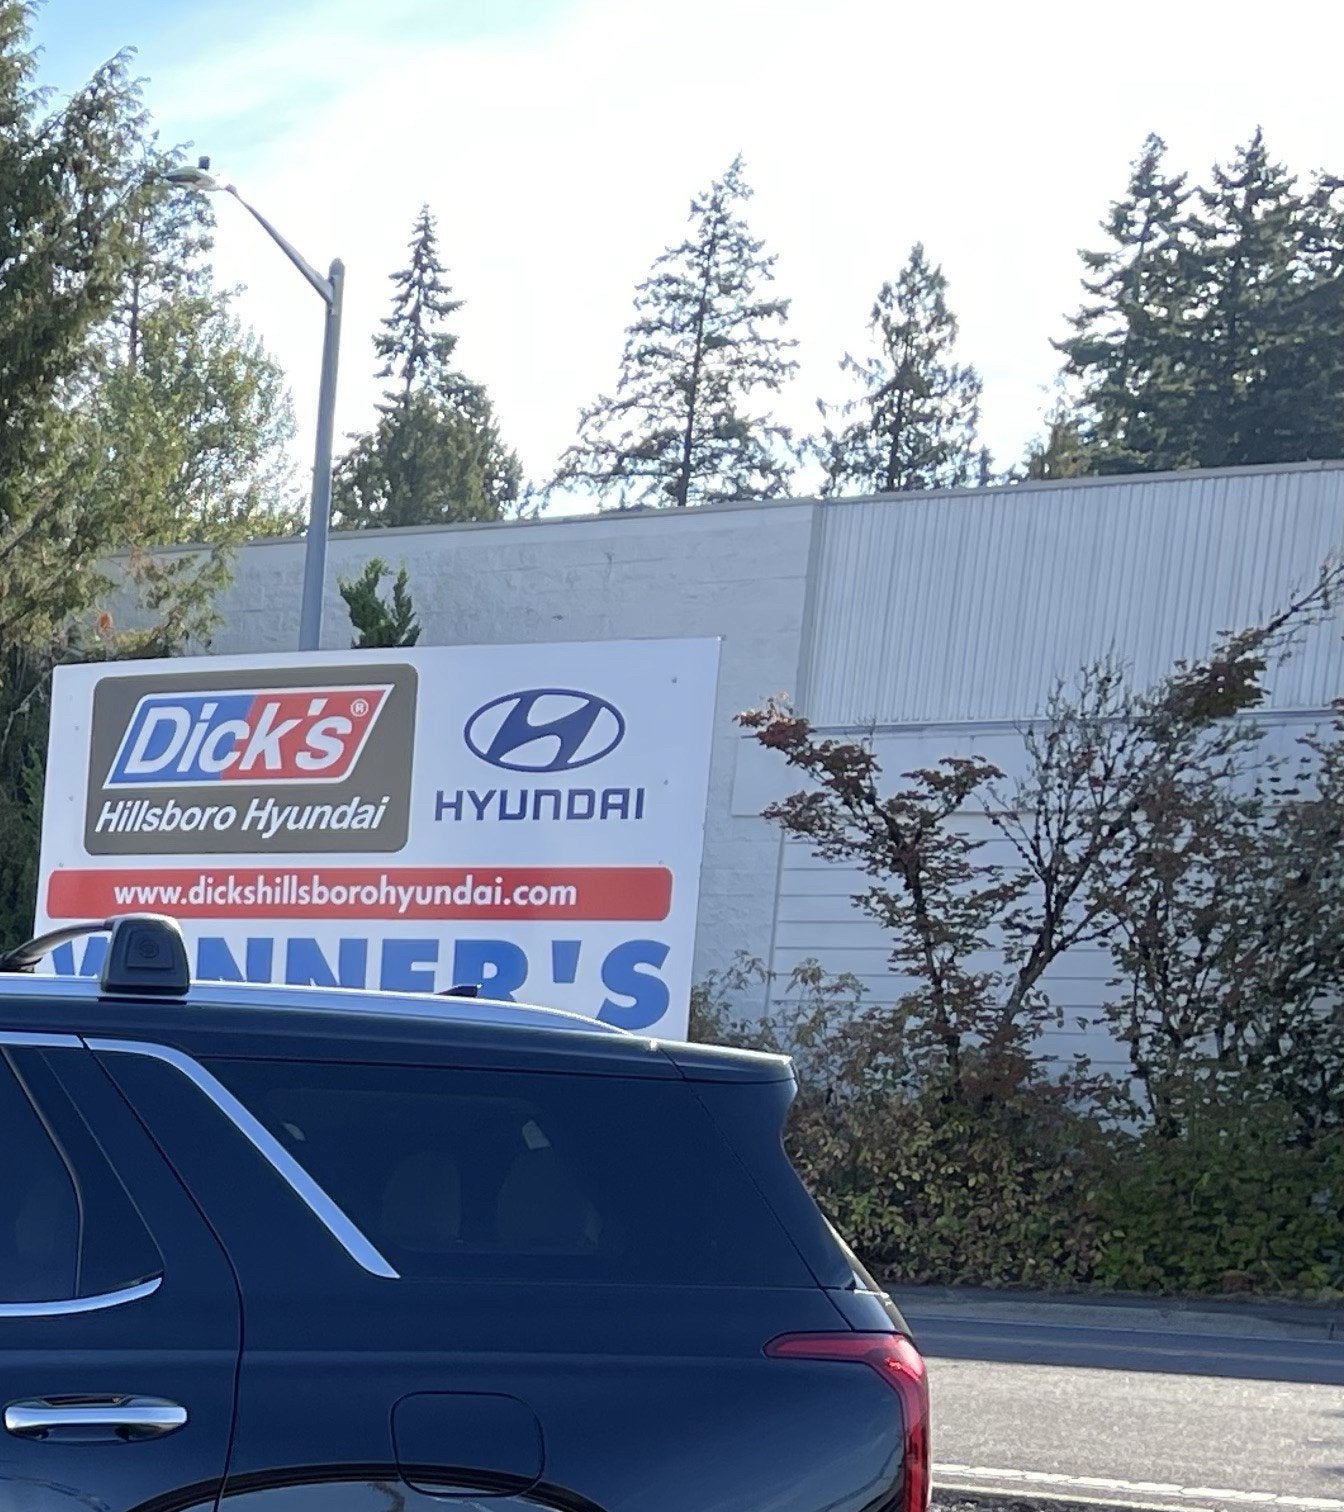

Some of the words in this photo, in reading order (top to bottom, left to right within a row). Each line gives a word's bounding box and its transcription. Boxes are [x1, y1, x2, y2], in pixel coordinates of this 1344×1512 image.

[123, 697, 353, 774] Dick's
[94, 799, 238, 833] Hillsboro
[240, 795, 390, 839] Hyundai
[434, 787, 645, 821] HYUNDAI
[113, 875, 577, 914] www.dickshillsborohyundai.com
[52, 937, 671, 1031] NNER'S
